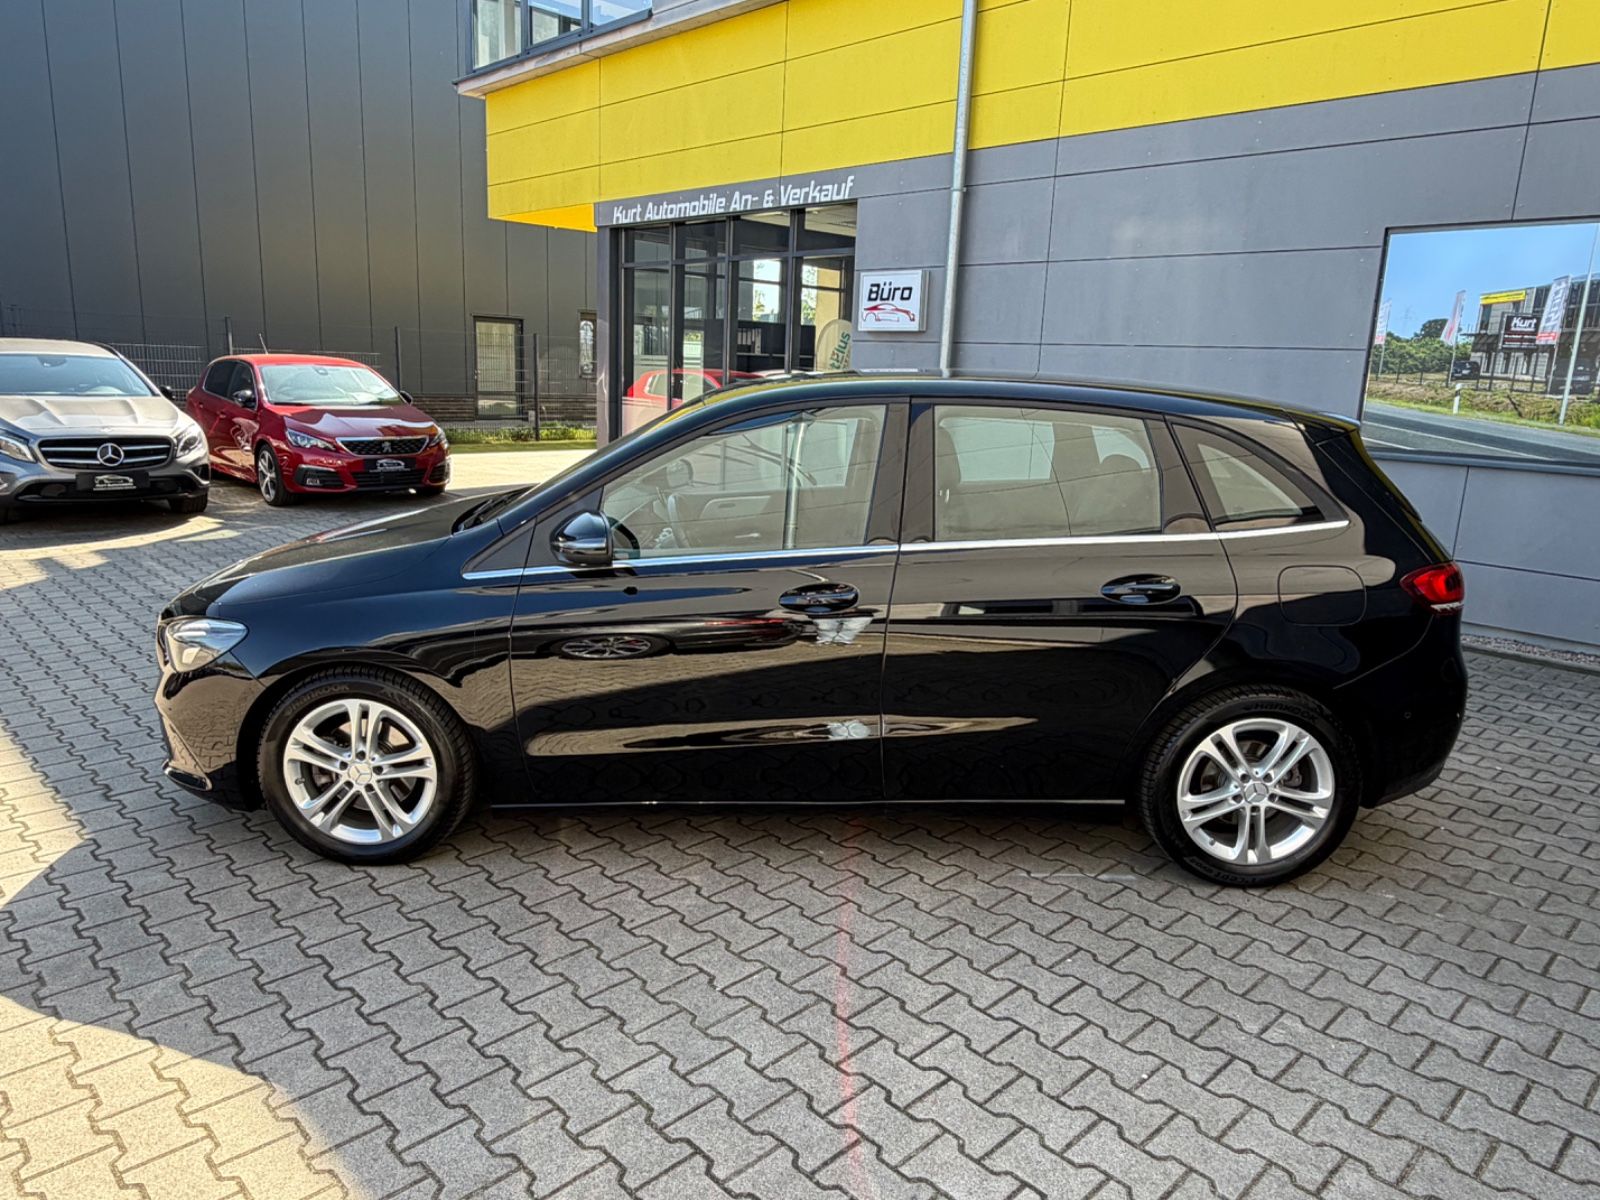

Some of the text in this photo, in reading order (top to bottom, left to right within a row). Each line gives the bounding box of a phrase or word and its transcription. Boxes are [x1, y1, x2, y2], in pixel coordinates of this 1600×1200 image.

[613, 175, 855, 225] Kurt Automobile An- & Verkauf
[867, 281, 913, 302] Büro
[1511, 316, 1538, 328] Kurt
